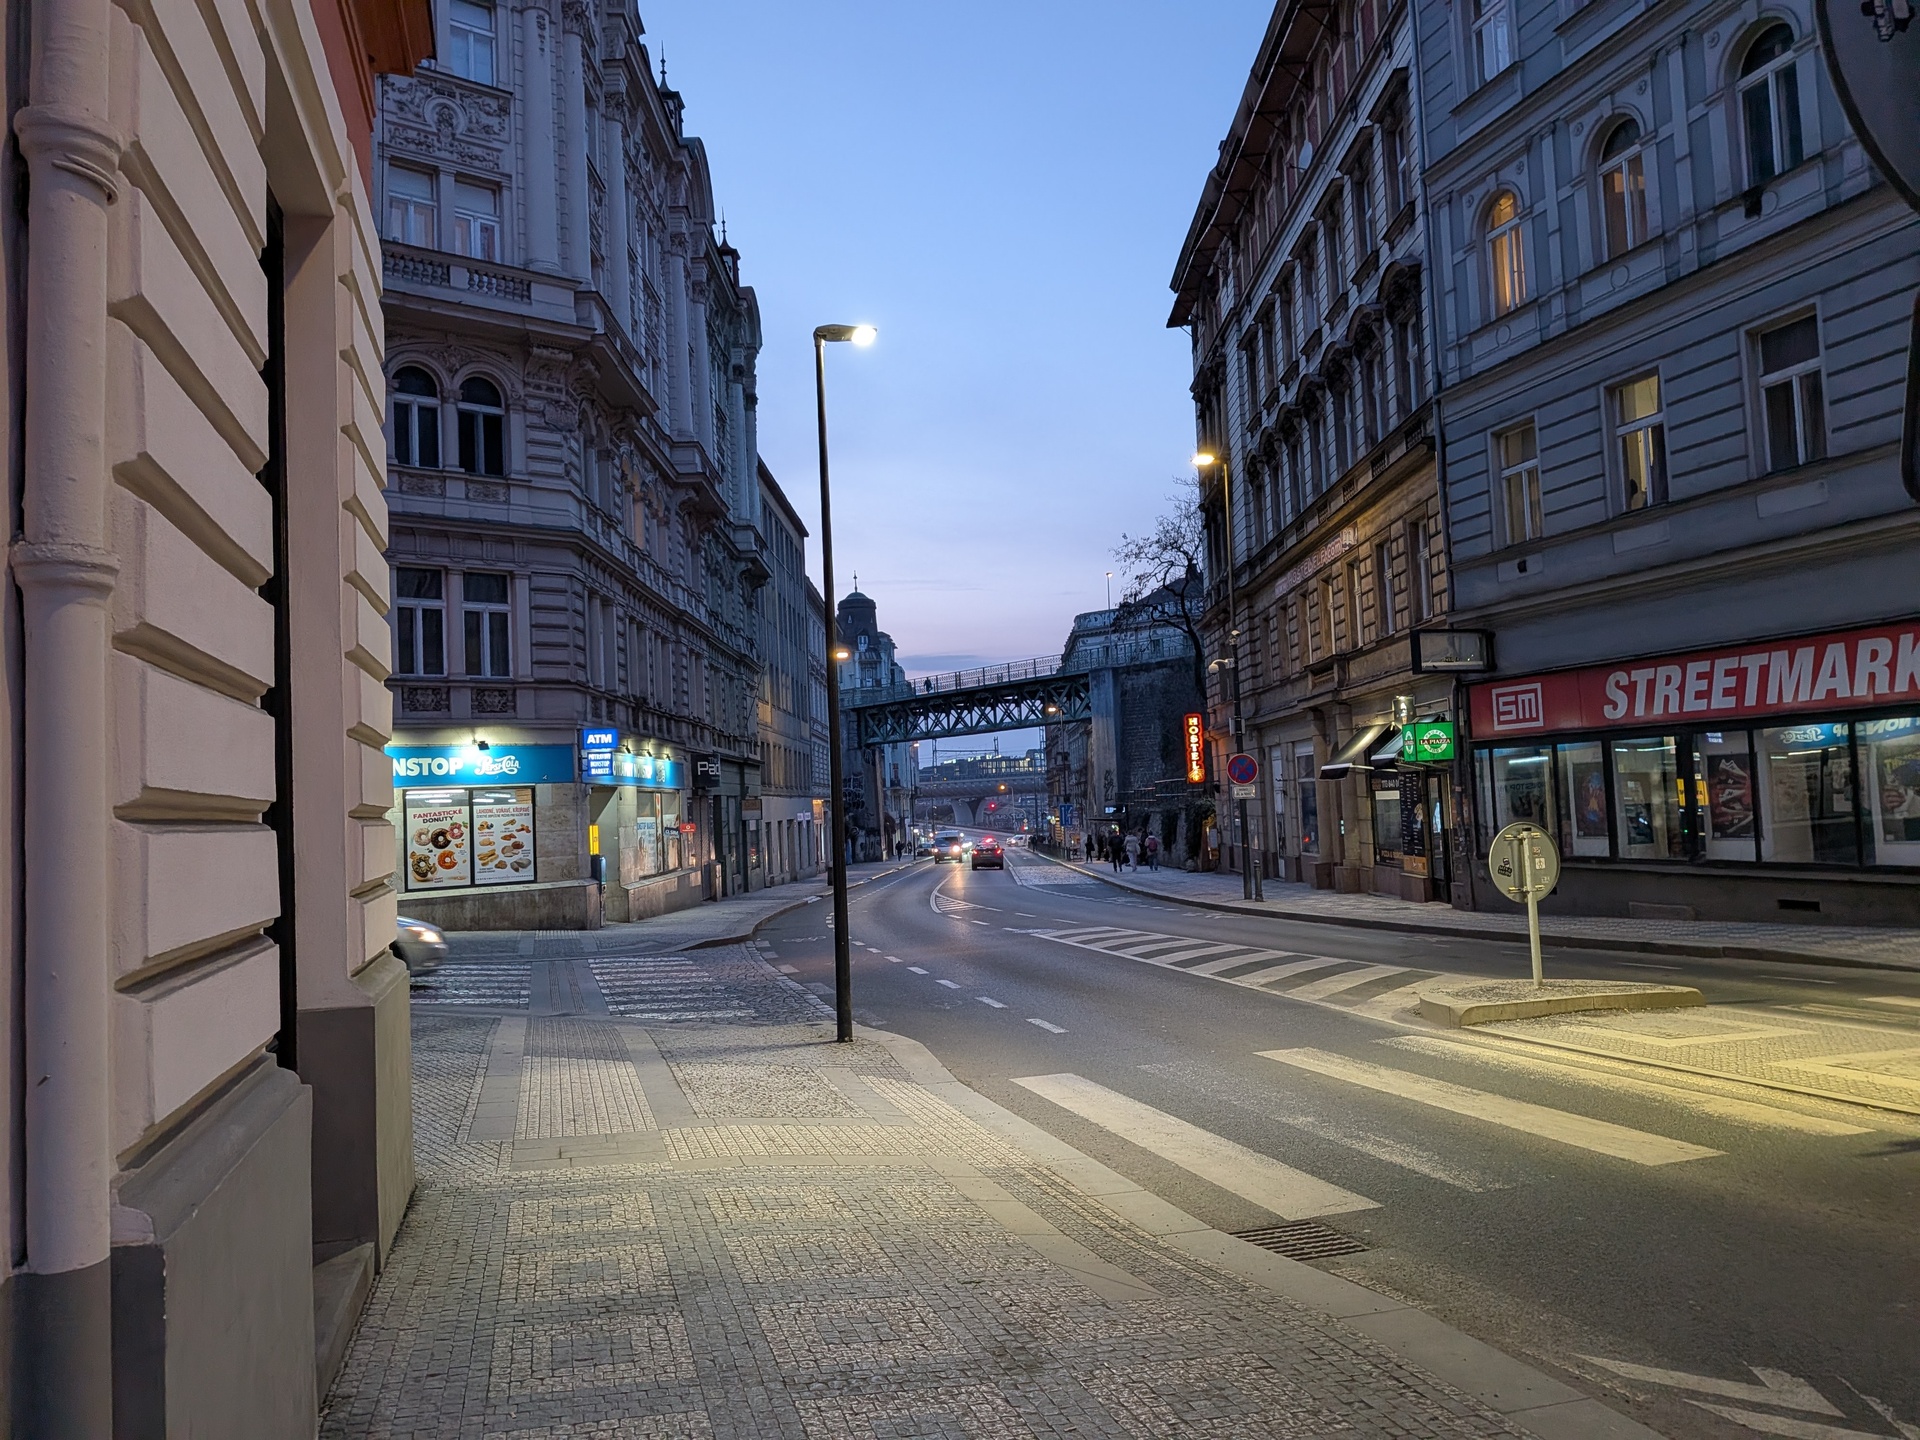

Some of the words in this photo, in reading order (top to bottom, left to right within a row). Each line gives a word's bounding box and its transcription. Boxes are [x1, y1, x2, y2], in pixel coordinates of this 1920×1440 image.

[1603, 632, 1920, 720] STREETMARK
[587, 734, 612, 744] ATM
[1188, 717, 1199, 770] HOSTEL
[393, 757, 464, 776] NSTOP
[413, 808, 463, 819] FANTASTICKÉ
[422, 815, 454, 824] DONUTY
